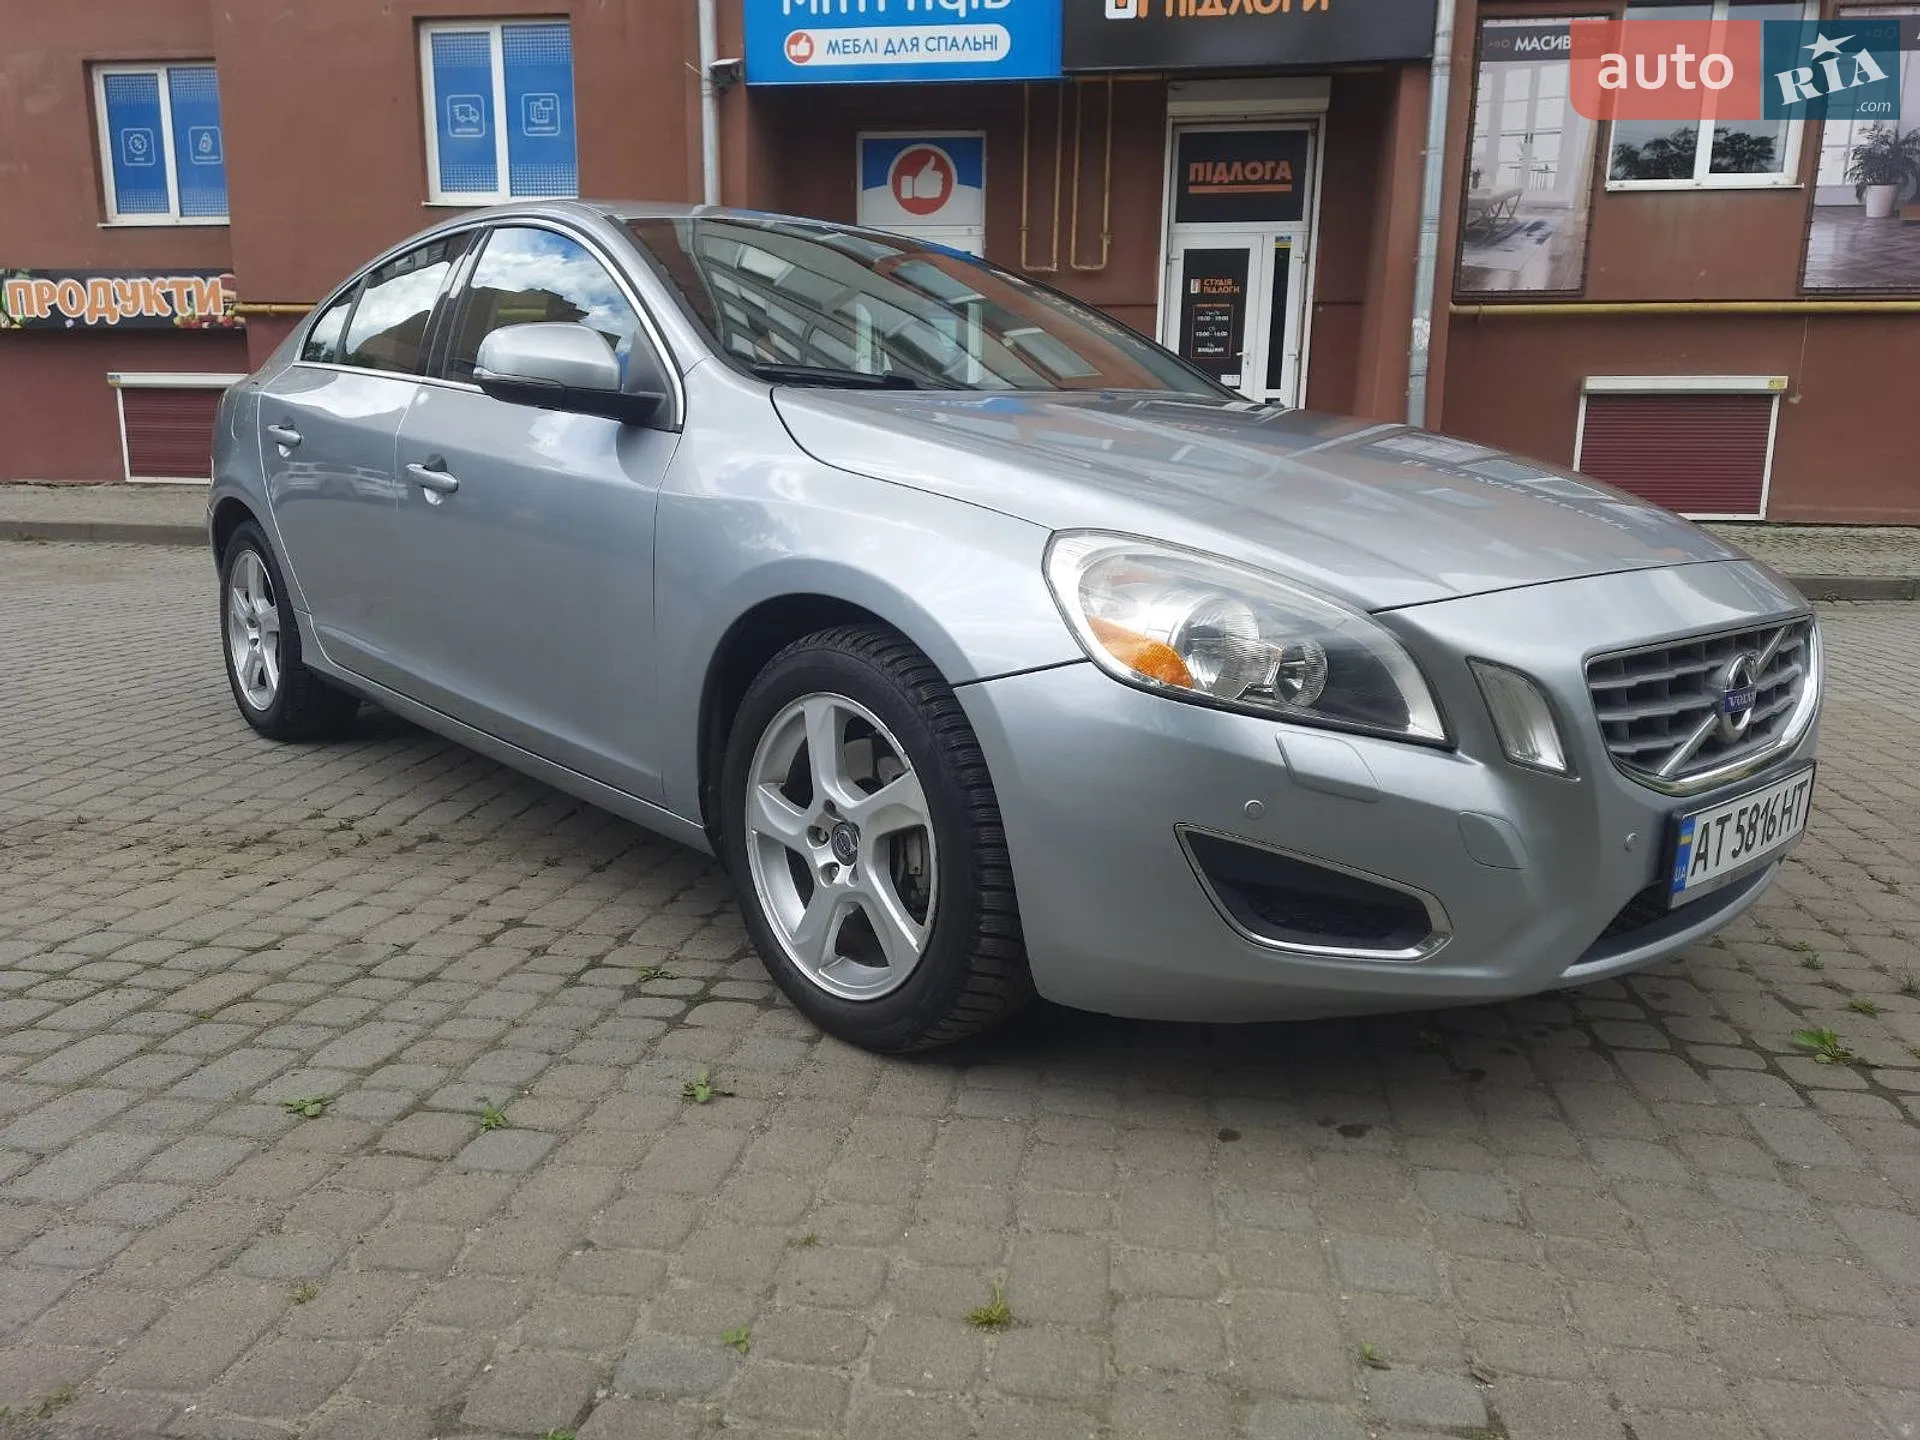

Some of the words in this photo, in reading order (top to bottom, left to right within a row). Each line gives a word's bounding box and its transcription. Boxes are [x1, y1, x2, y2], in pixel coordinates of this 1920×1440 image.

[827, 38, 878, 55] МЕБЛІ
[884, 37, 919, 56] ДЛЯ
[925, 35, 998, 52] СПАЛЬНІ
[1189, 160, 1292, 183] ПІДЛОГА
[6, 278, 224, 325] ПРОДУКТИ
